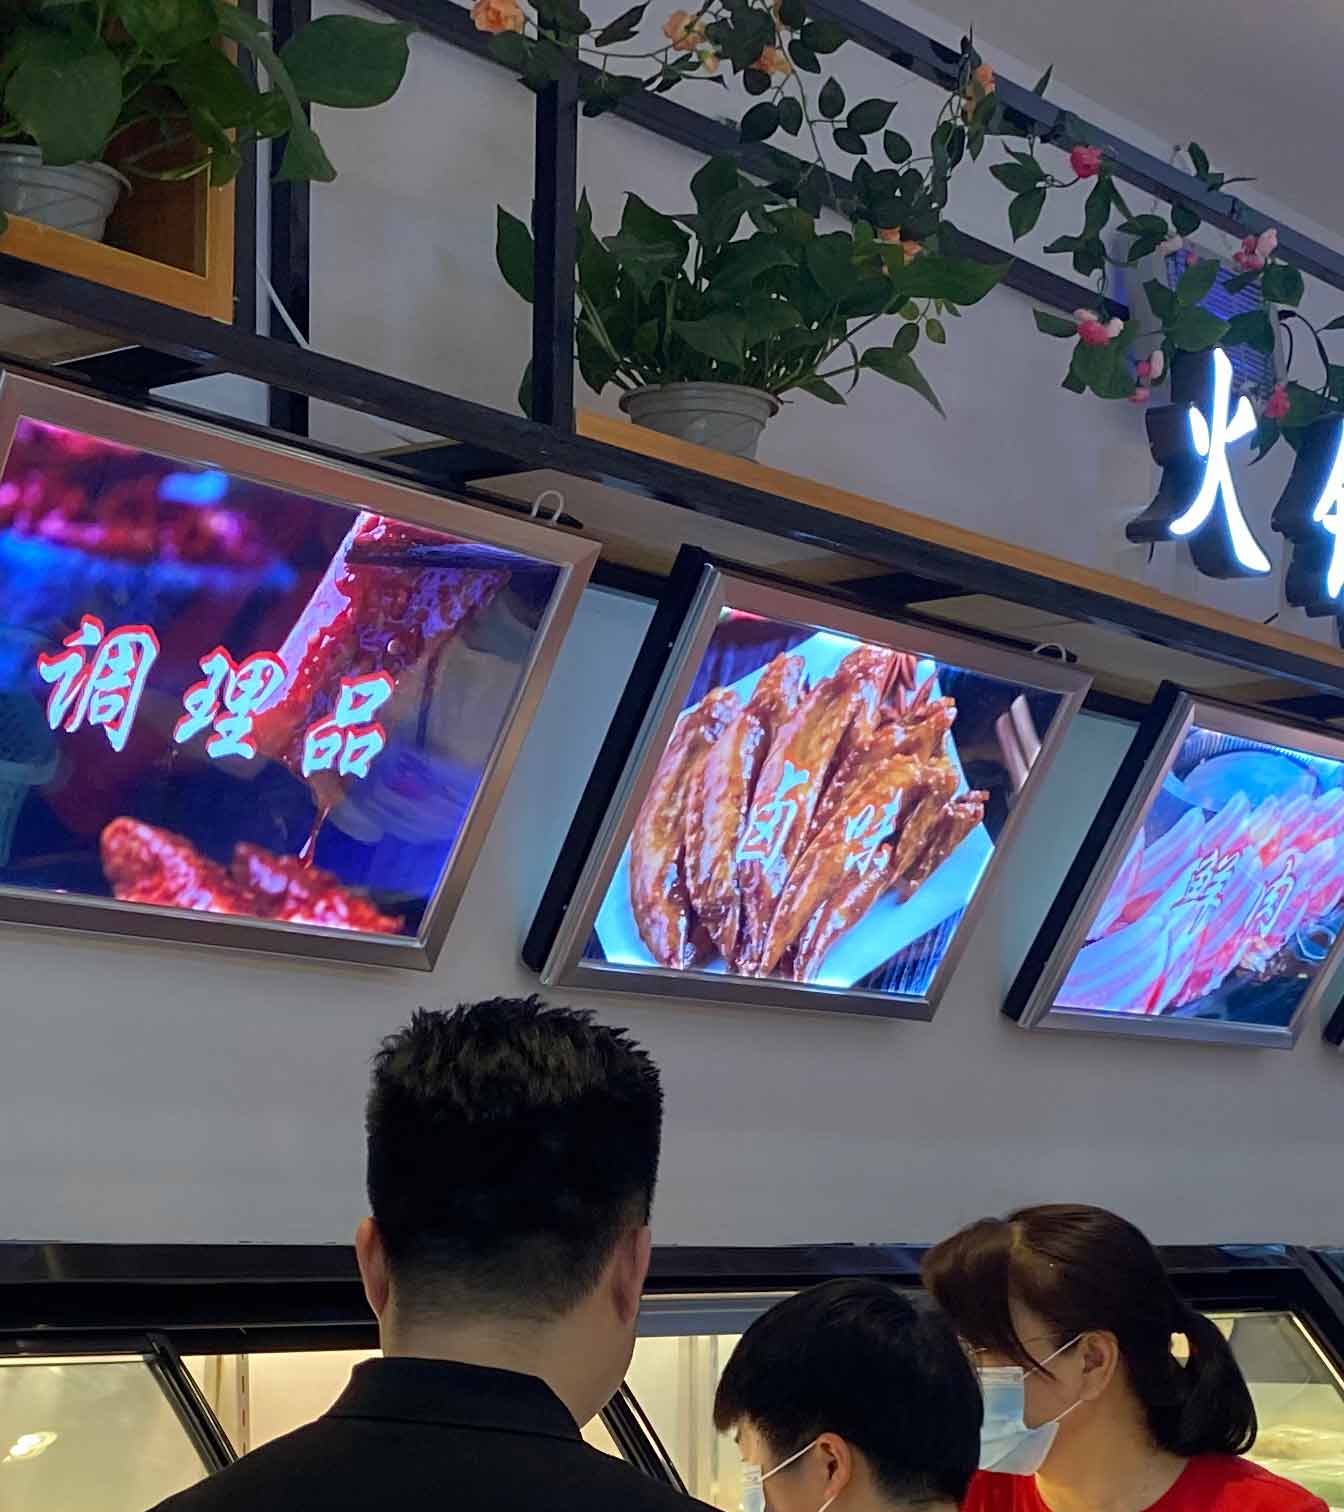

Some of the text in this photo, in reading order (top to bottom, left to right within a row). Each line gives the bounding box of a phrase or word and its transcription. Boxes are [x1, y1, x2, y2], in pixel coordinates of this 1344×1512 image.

[37, 613, 394, 779] 调理品
[1170, 848, 1297, 938] 鲜肉
